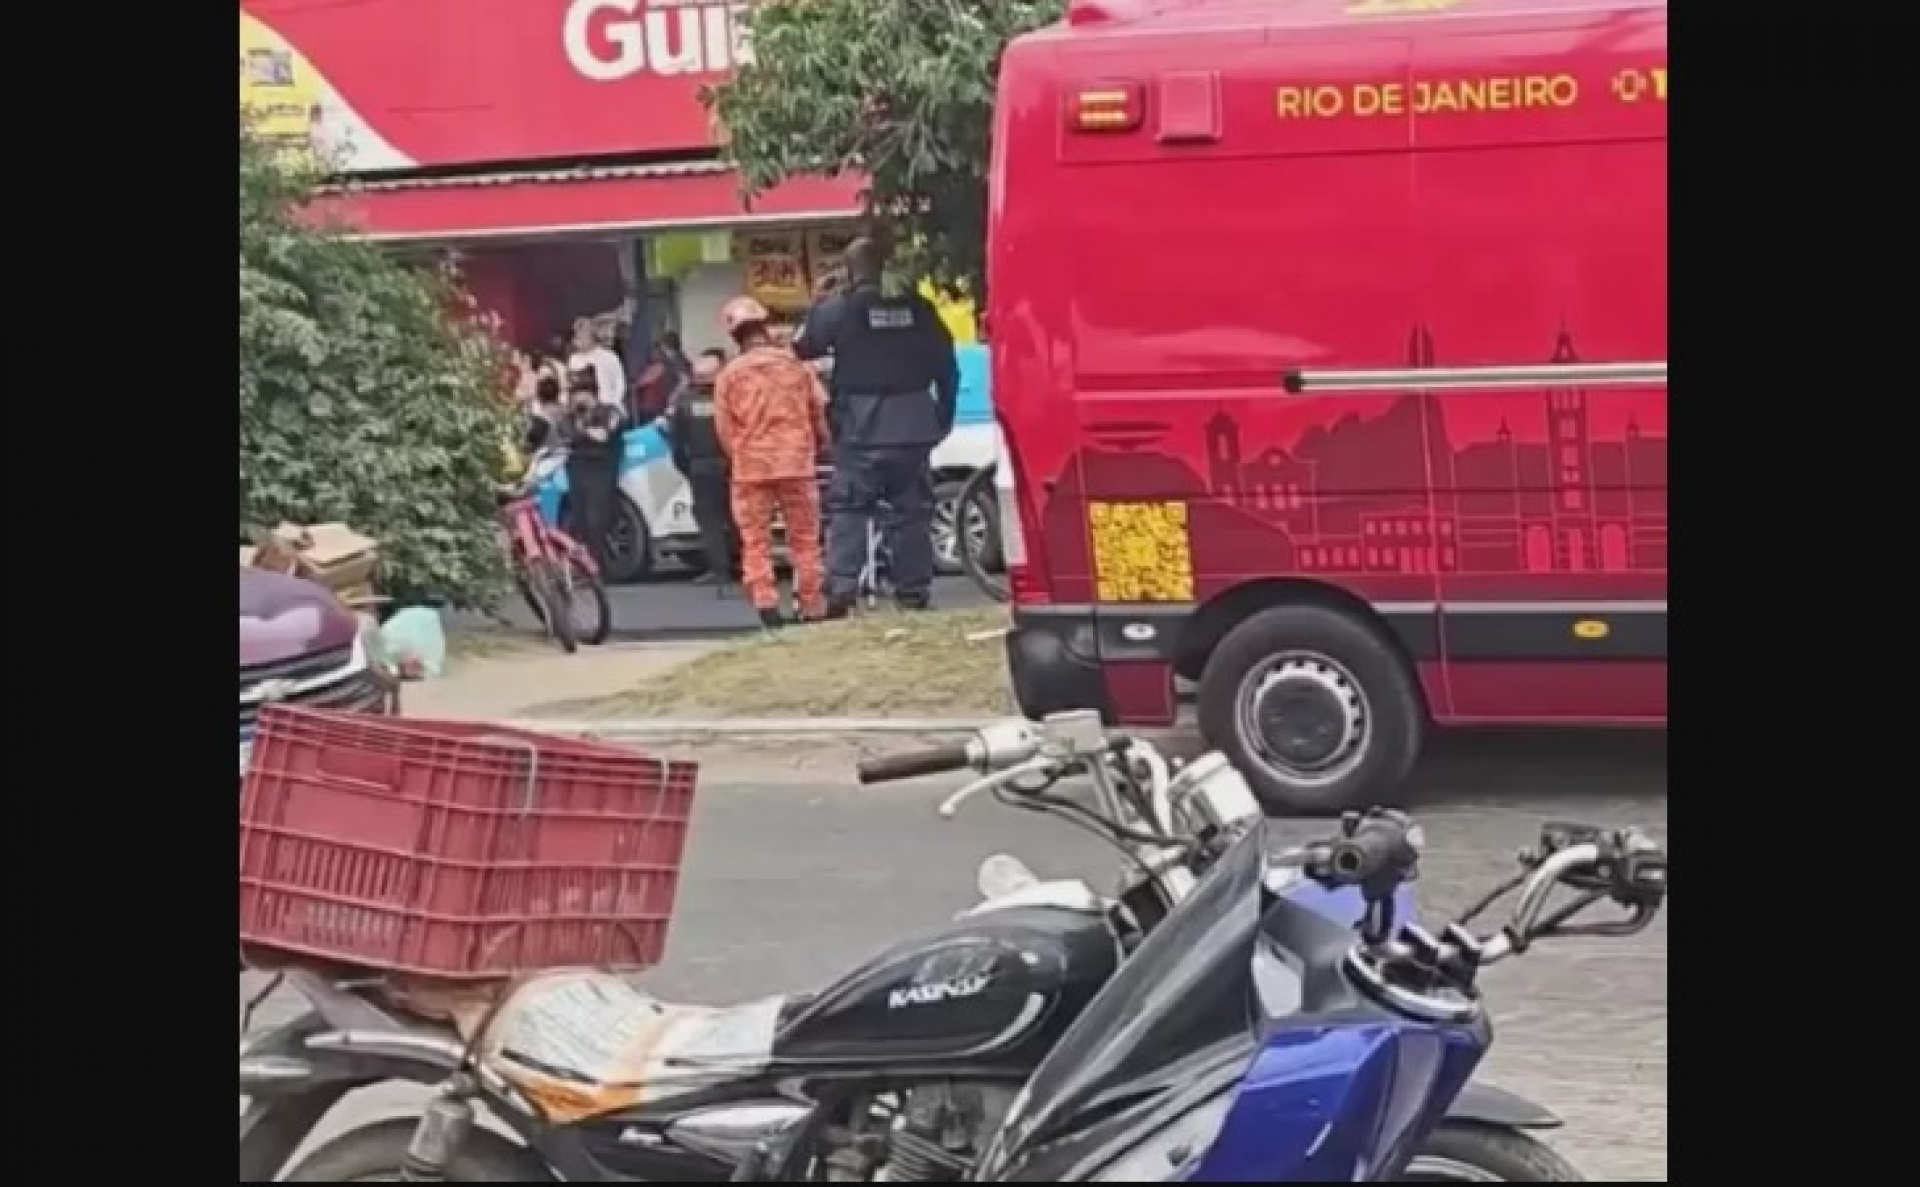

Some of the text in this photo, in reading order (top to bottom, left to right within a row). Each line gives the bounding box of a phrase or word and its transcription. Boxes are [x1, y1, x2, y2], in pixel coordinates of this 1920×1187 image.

[1277, 84, 1343, 119] RIO
[1354, 82, 1404, 116] DE
[1413, 74, 1578, 114] JANEIRO
